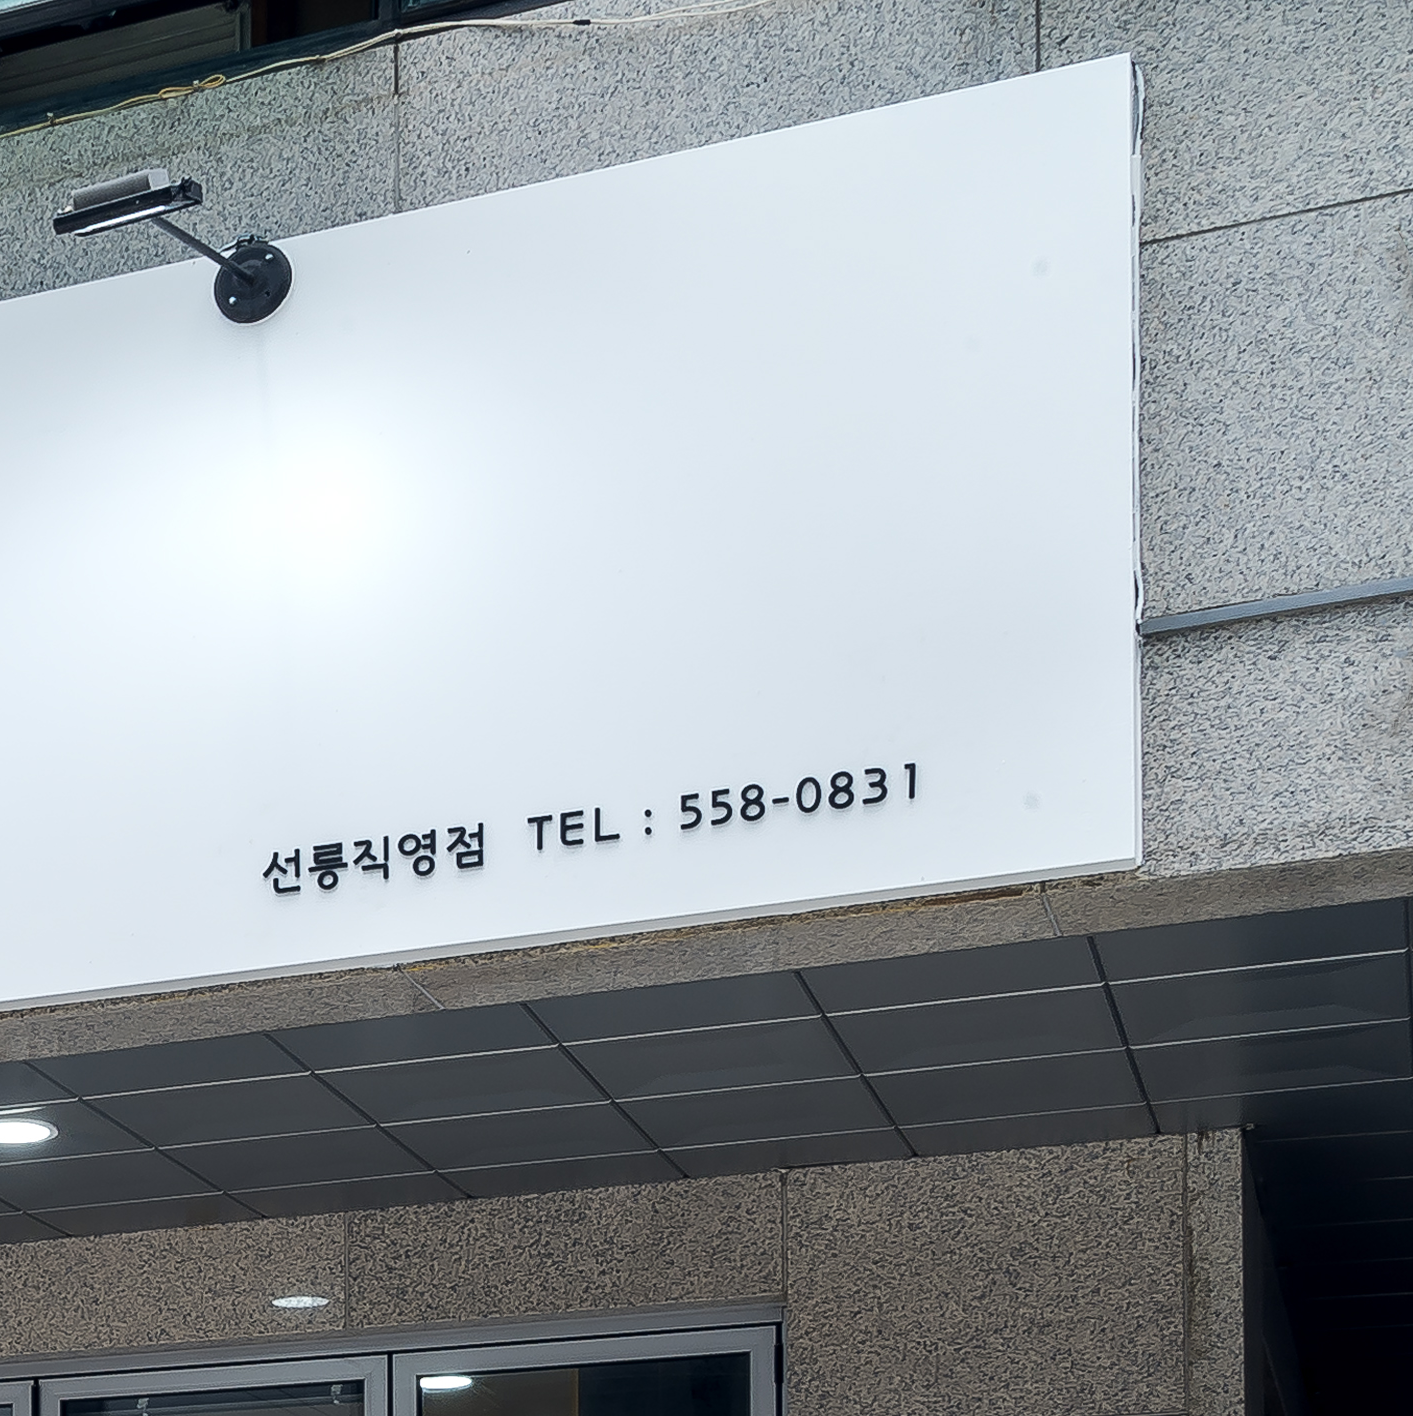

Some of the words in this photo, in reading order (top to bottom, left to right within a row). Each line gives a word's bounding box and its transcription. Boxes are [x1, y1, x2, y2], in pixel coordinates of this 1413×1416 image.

[262, 822, 485, 896] 선릉직영점
[527, 806, 621, 851] TEL
[679, 762, 919, 831] 558-0831
